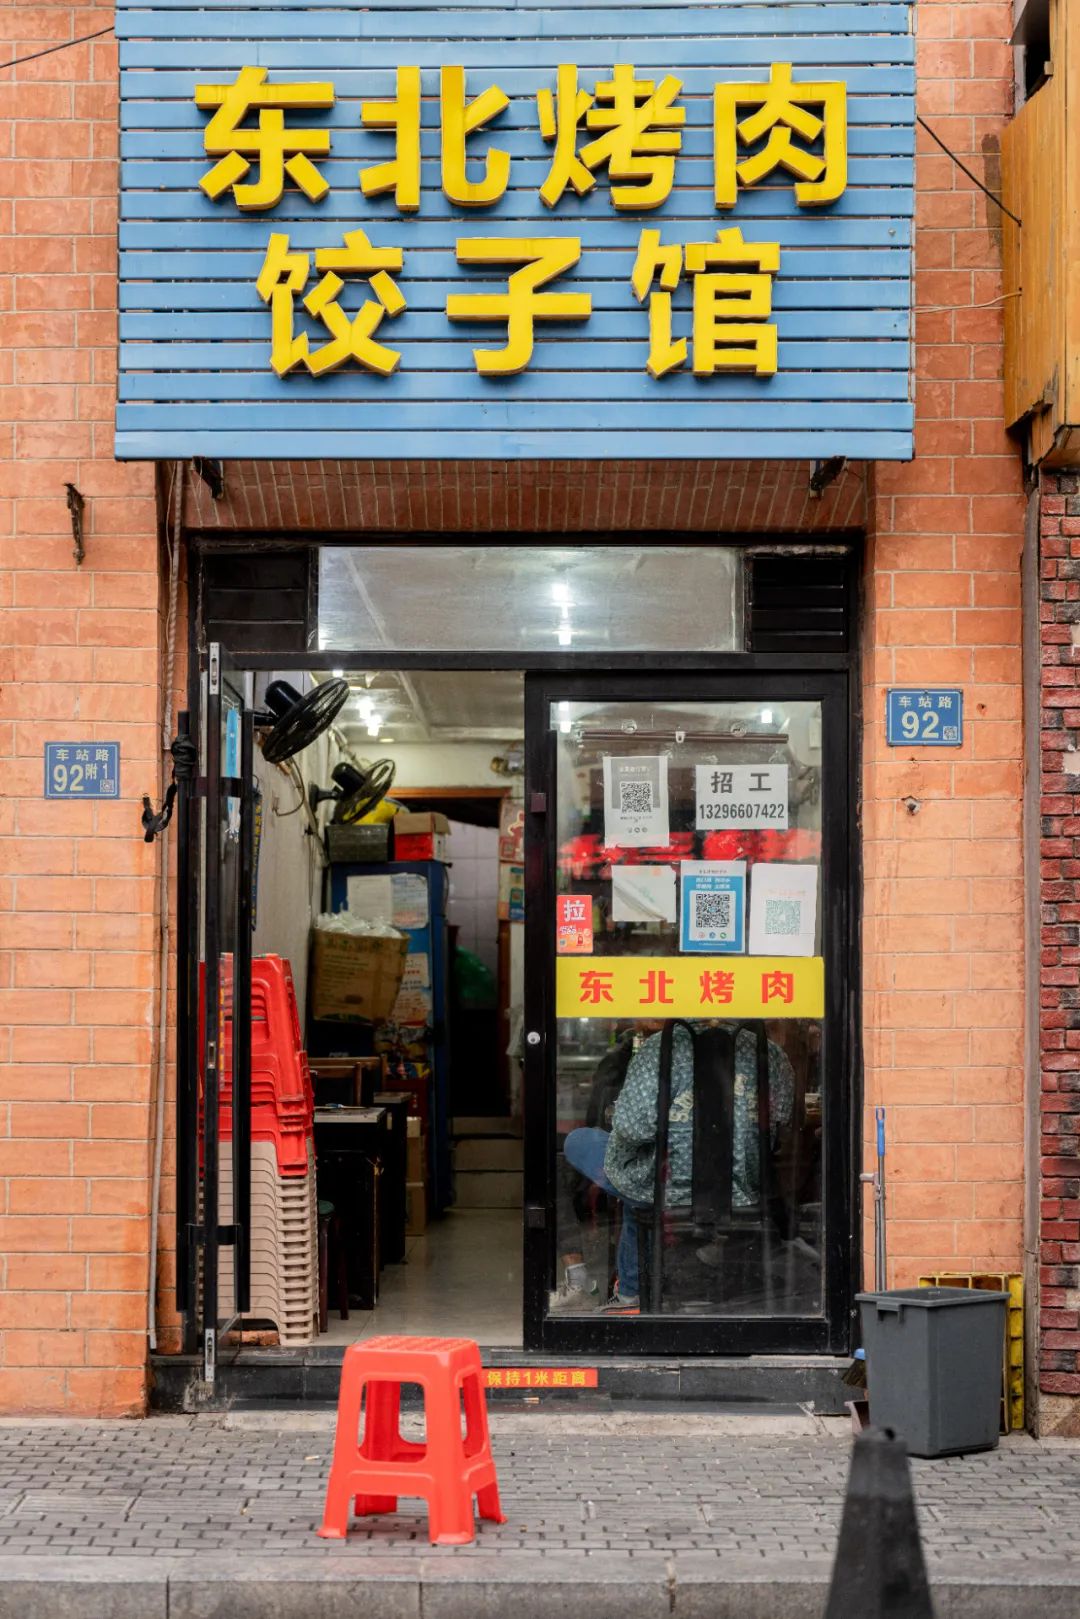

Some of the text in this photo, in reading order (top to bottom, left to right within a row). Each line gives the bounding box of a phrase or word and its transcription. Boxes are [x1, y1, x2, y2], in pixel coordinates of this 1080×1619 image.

[195, 62, 848, 211] 东北烤肉
[256, 226, 781, 379] 饺子馆
[898, 695, 953, 709] 车站路
[901, 711, 940, 739] 92
[55, 748, 110, 761] 车站路
[710, 771, 773, 794] 招工
[699, 803, 785, 820] 13296607422
[579, 970, 795, 1004] 东北烤肉
[487, 1370, 586, 1386] 保持1米距离
